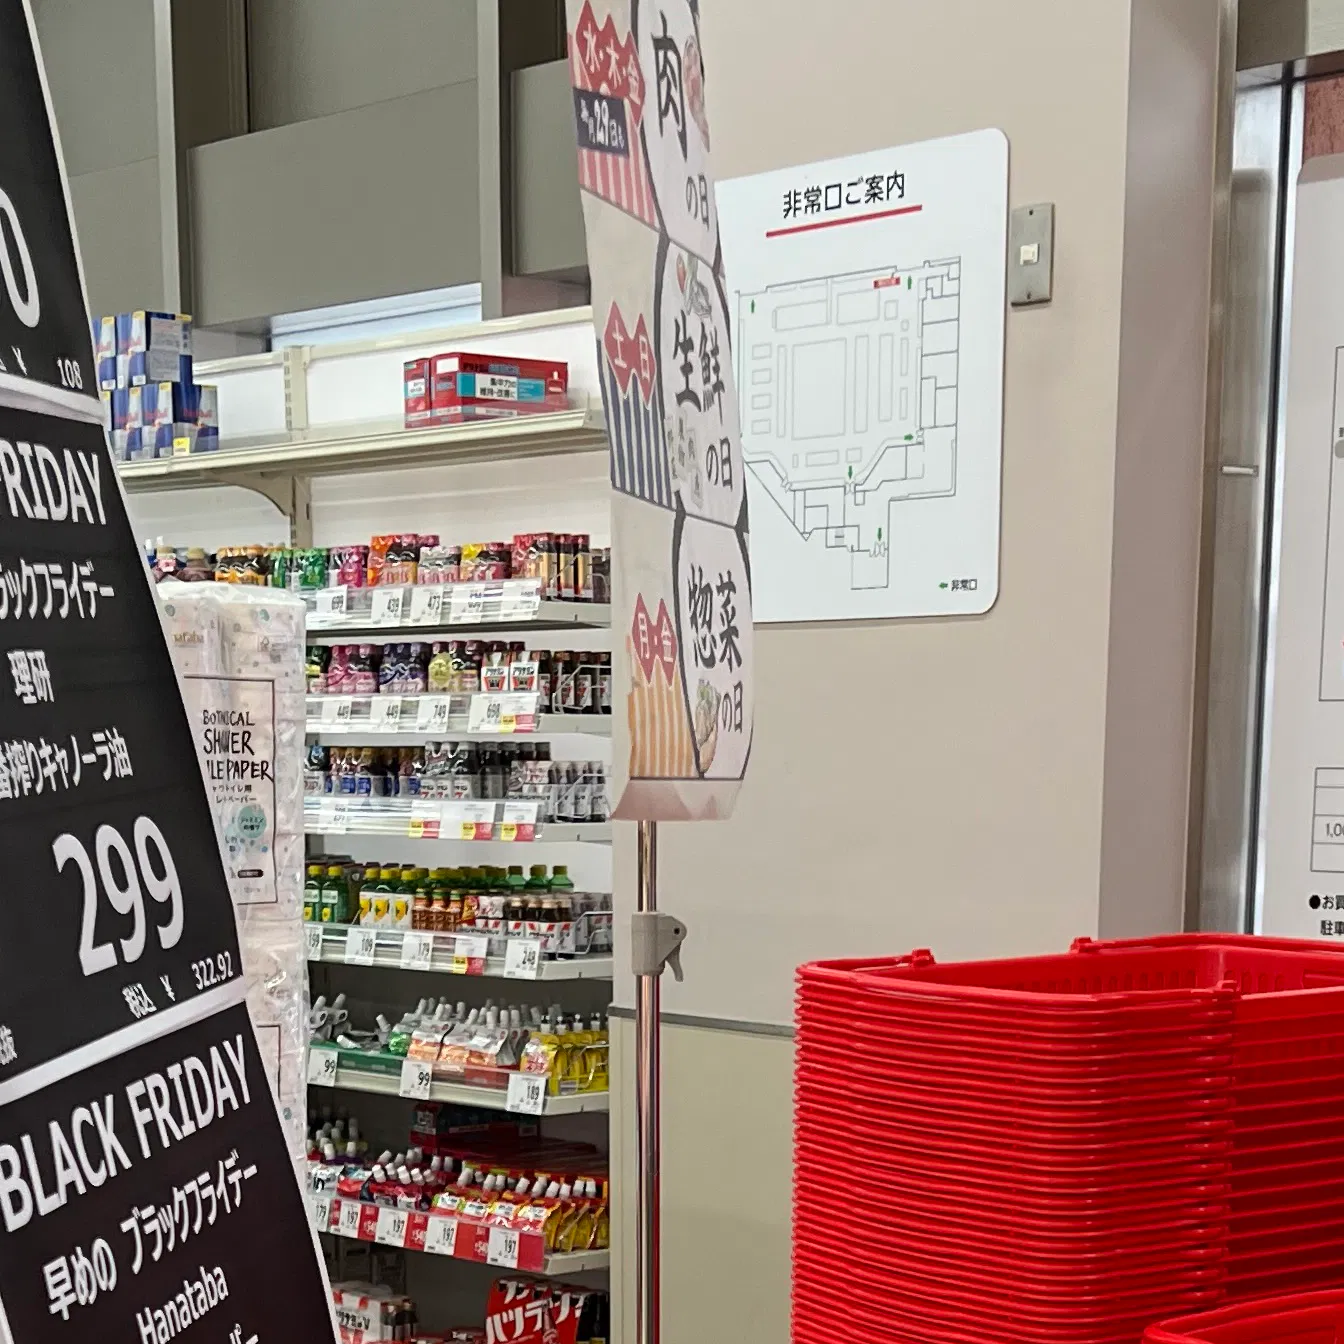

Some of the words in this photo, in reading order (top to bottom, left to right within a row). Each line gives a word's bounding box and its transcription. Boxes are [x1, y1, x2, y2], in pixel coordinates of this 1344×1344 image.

[781, 170, 906, 221] 非常口ご案内
[56, 358, 85, 391] 108
[6, 650, 55, 706] 理研
[52, 815, 186, 977] 299
[120, 982, 157, 1019] 税込
[189, 949, 234, 991] 322.92
[324, 1059, 335, 1073] 99
[418, 1071, 430, 1086] 99
[125, 1033, 255, 1156] FRIDAY
[41, 1242, 118, 1322] 早めの
[125, 1149, 258, 1277] ブラックフライデー
